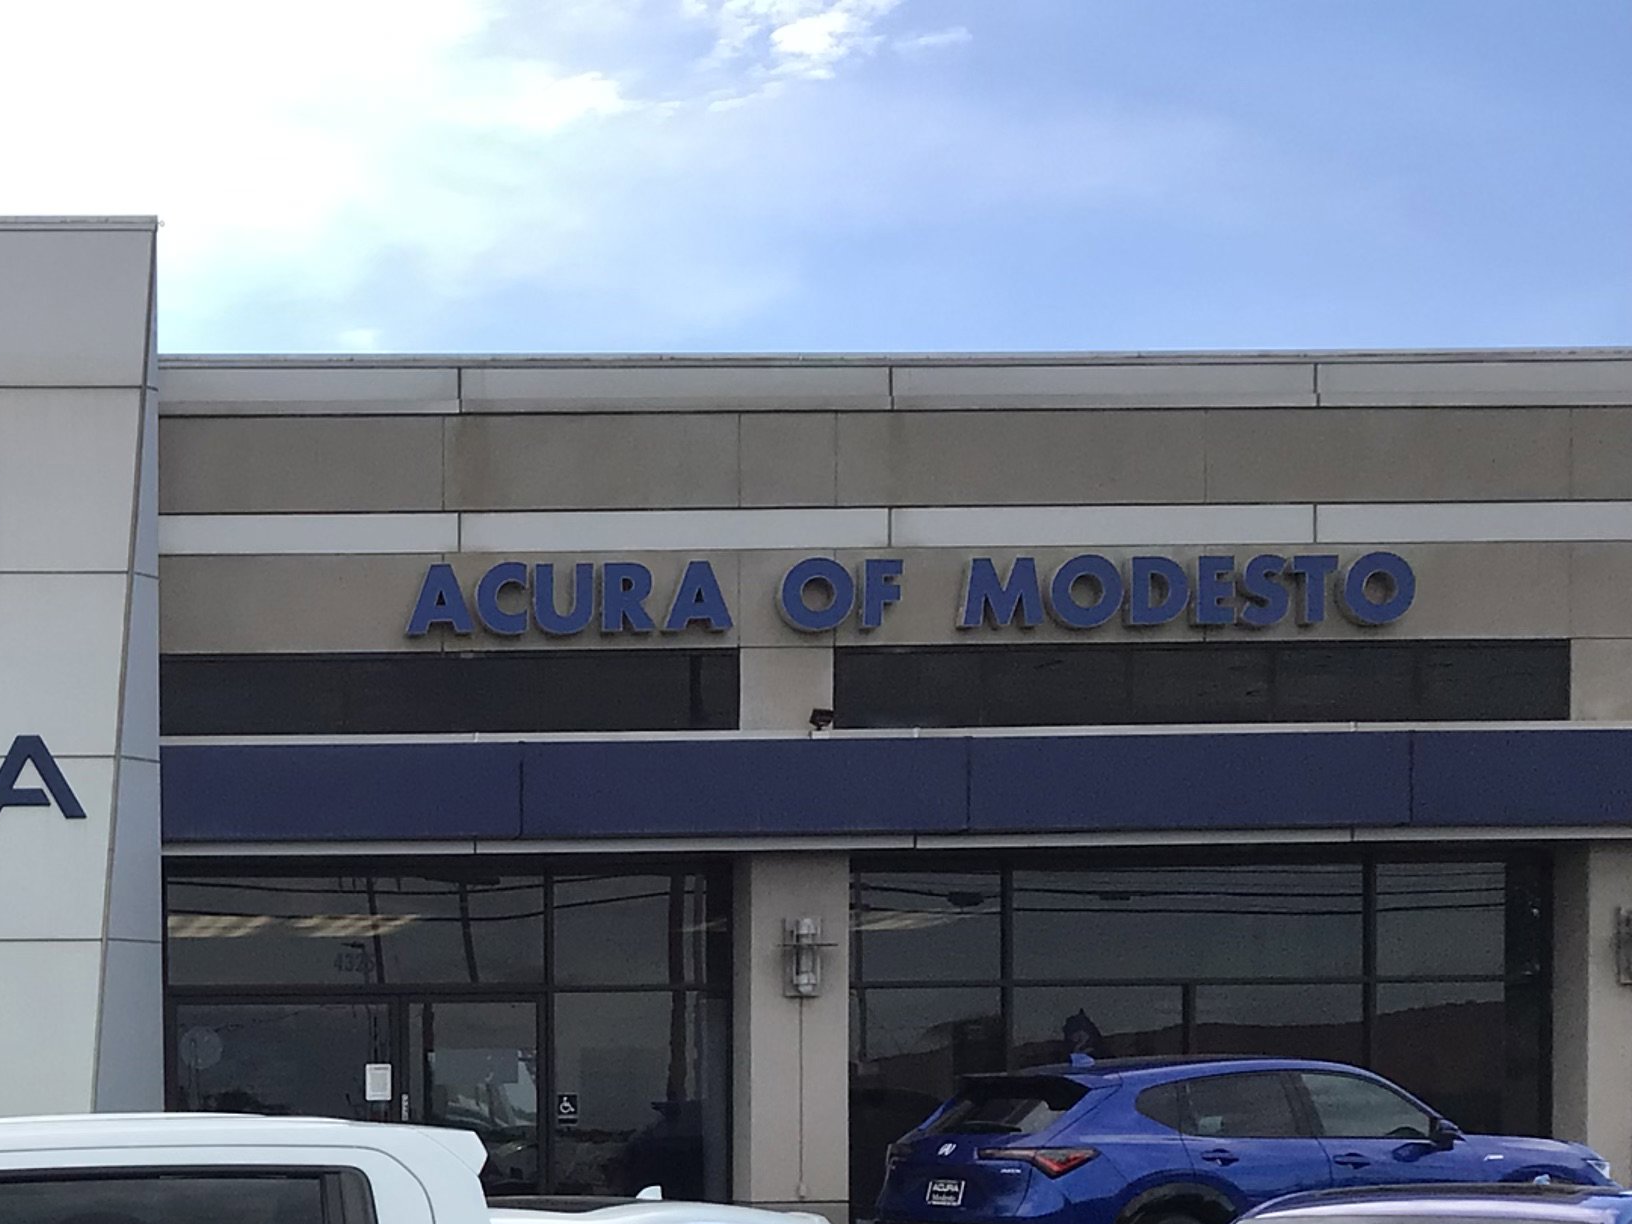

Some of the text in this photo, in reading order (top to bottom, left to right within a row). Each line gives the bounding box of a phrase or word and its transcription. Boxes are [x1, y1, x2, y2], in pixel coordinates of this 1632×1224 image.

[405, 551, 1416, 638] ACURA OF MODESTO
[932, 1183, 959, 1192] ACURA
